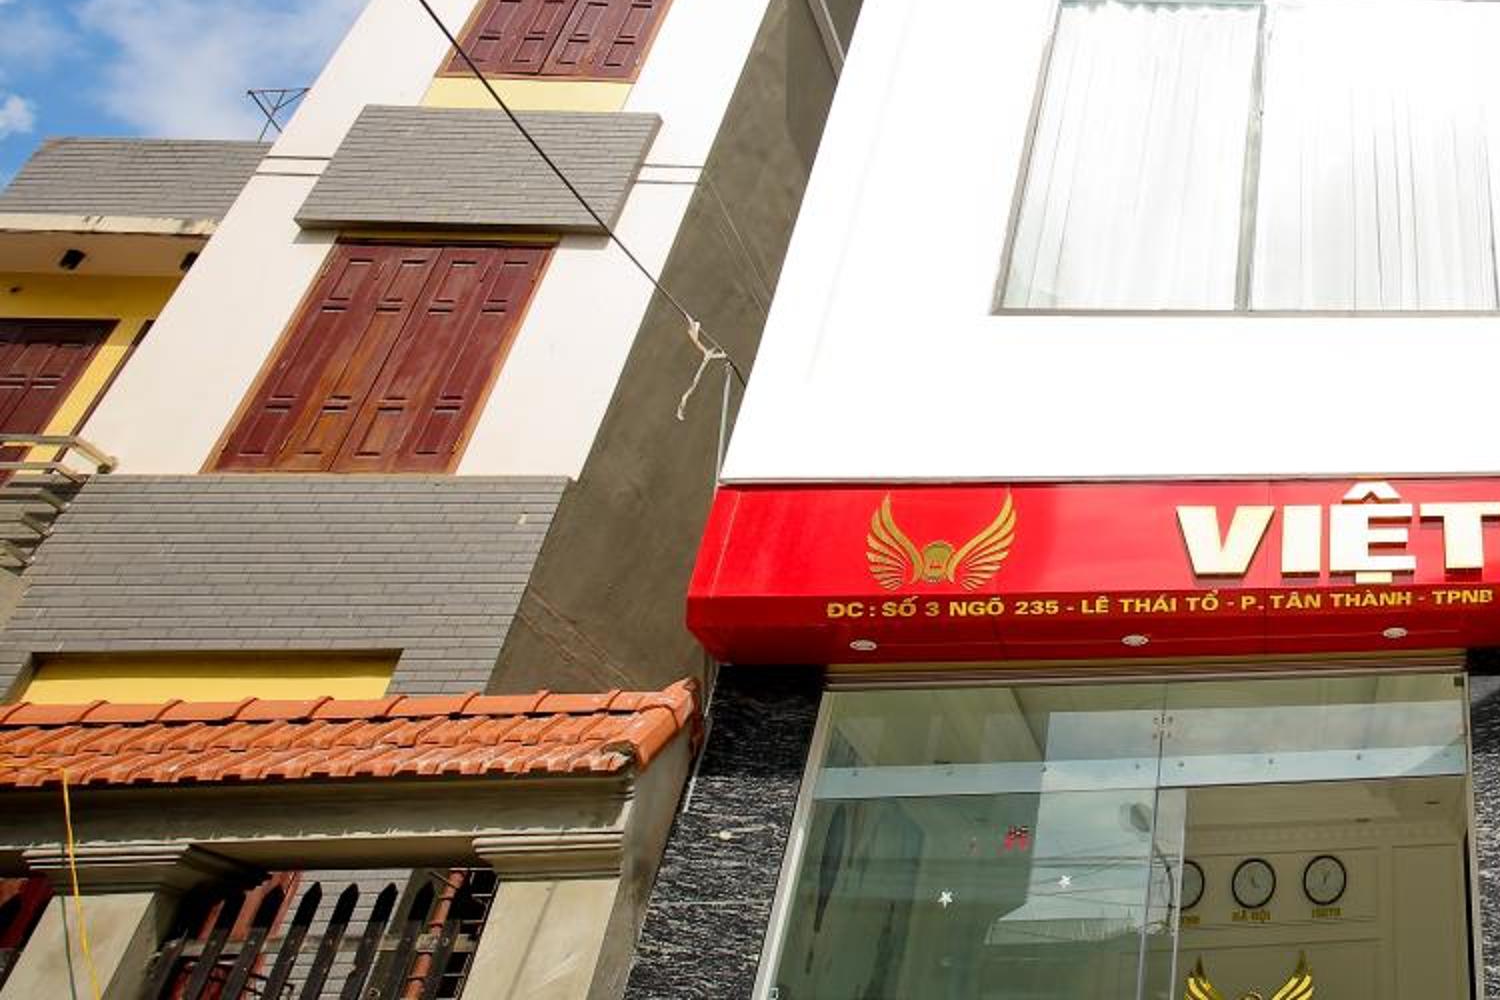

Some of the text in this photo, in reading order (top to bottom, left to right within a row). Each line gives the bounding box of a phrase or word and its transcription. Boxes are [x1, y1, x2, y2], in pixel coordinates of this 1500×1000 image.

[881, 595, 919, 617] SỐ
[924, 602, 940, 617] 3
[1014, 600, 1060, 615] 235
[1081, 595, 1110, 614] LÊ
[1119, 594, 1177, 613] THÁI
[1269, 591, 1322, 609] TÂN
[1329, 589, 1413, 607] THÀNH
[1431, 588, 1494, 605] TPNB
